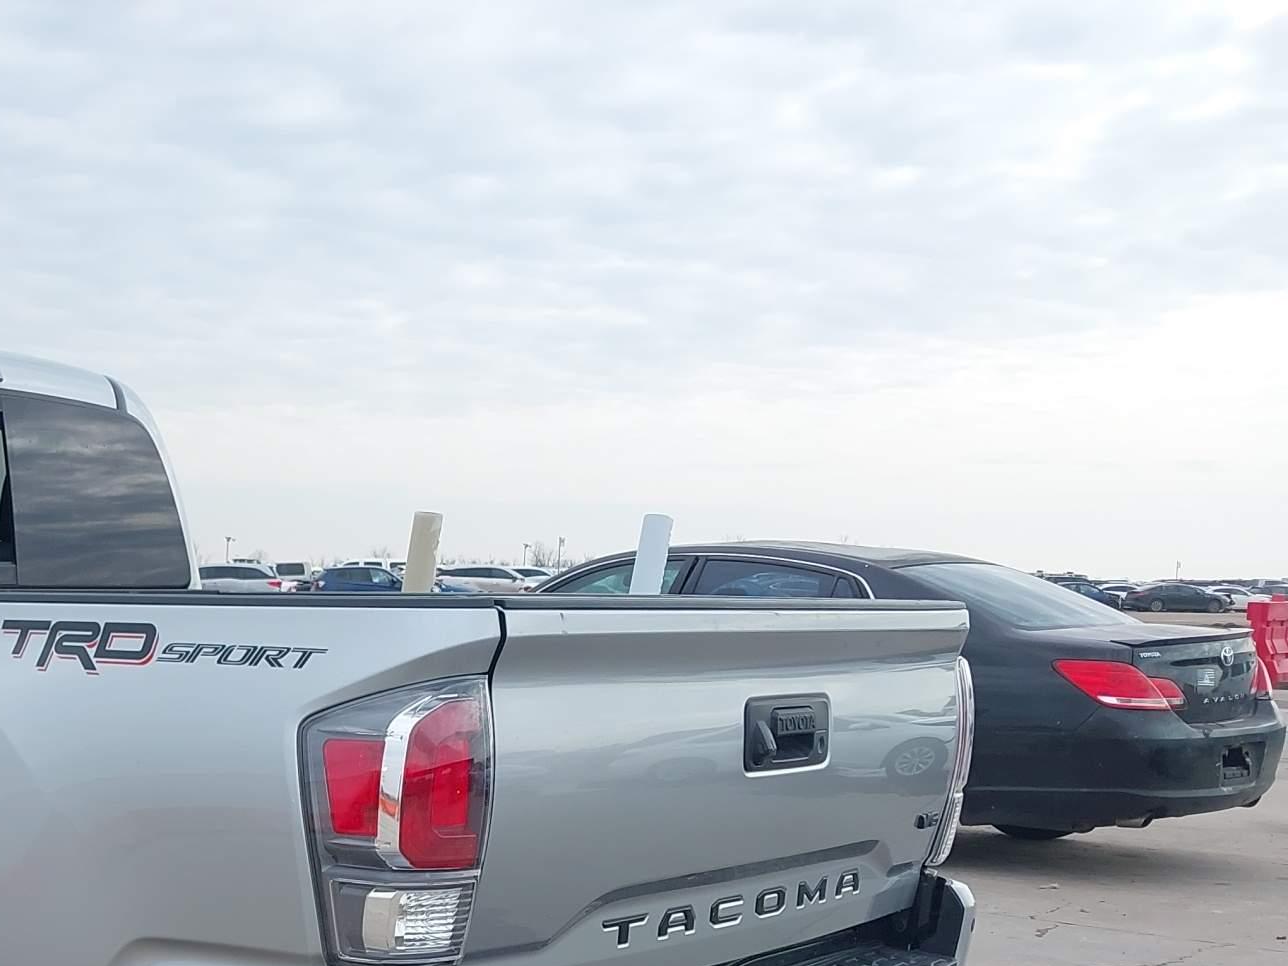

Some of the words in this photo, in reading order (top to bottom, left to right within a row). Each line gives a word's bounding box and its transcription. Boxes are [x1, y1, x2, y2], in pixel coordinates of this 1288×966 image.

[1, 619, 159, 675] TRD
[157, 642, 329, 669] SPORT
[778, 713, 816, 732] TOYOTA
[602, 867, 860, 949] TACOMA
